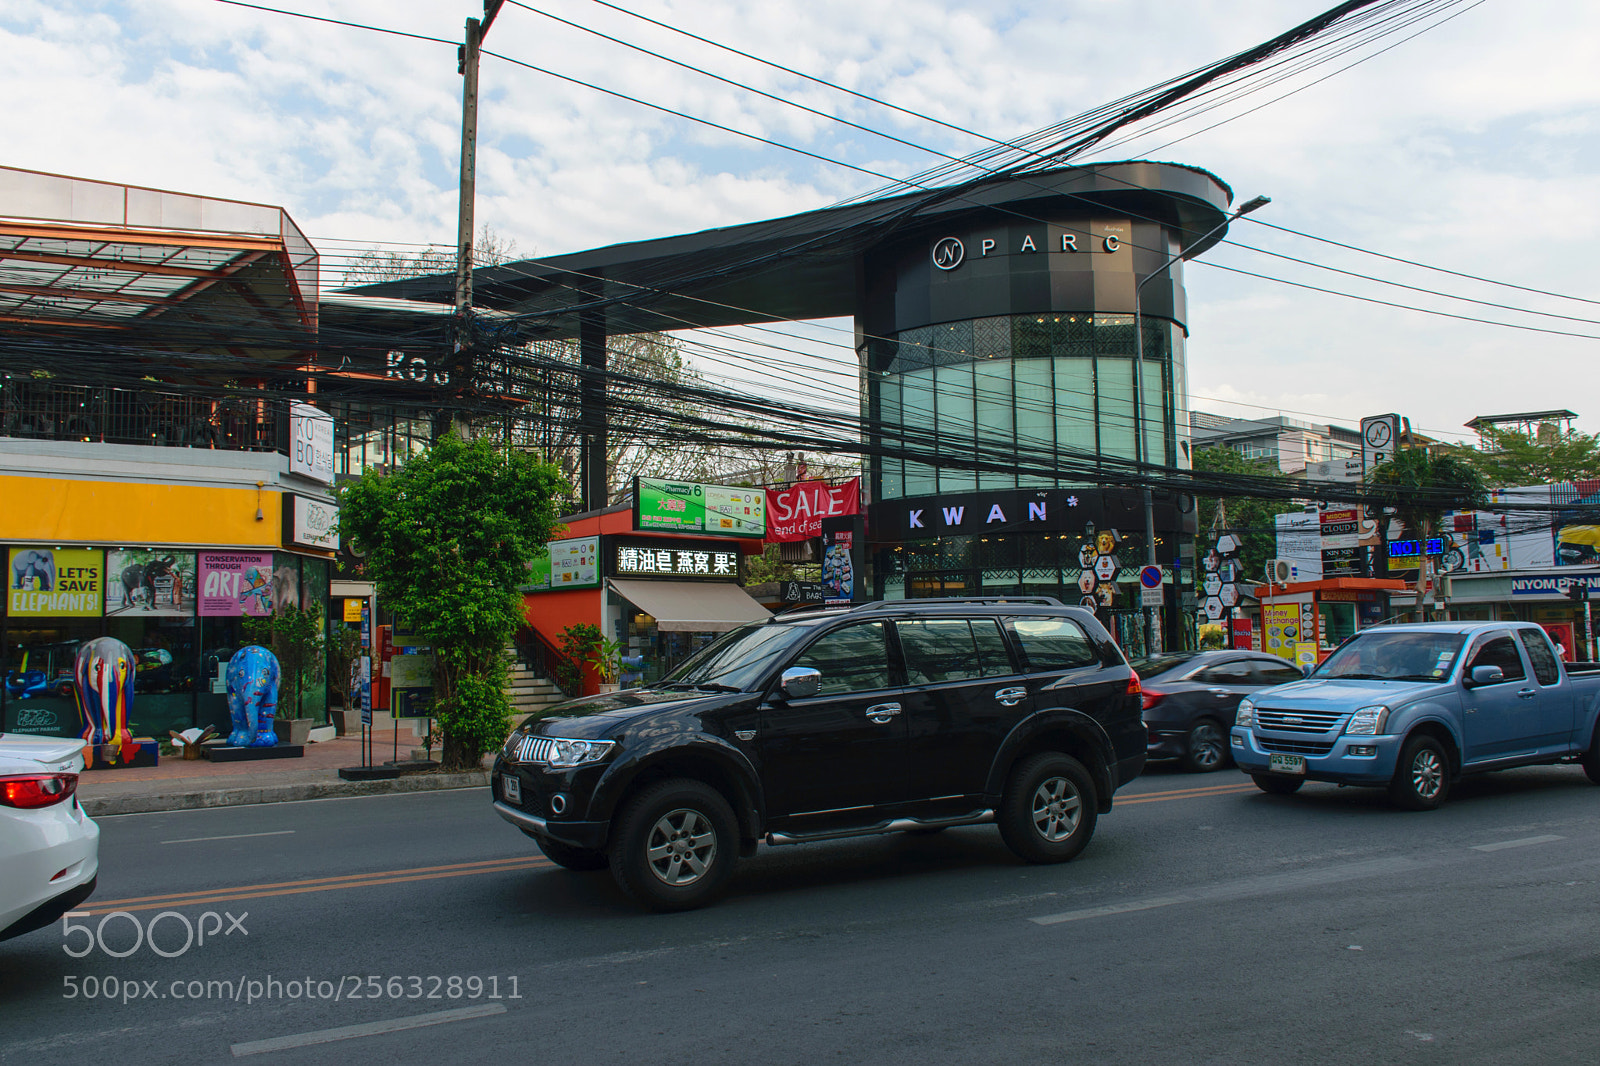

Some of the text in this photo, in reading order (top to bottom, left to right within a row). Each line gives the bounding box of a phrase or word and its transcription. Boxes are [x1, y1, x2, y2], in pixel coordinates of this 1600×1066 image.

[982, 234, 1120, 256] PARC
[296, 417, 313, 440] KO
[666, 486, 689, 494] Pharmacy
[694, 485, 702, 496] 6
[777, 488, 844, 521] SALE
[909, 501, 1047, 529] KWAN
[775, 522, 796, 535] end
[798, 520, 808, 533] of
[1391, 542, 1412, 555] NO
[620, 549, 672, 571] 精油皂
[677, 551, 709, 573] 燕窝
[59, 567, 98, 578] LET'S
[59, 580, 97, 591] SAVE
[204, 571, 242, 599] ART
[1512, 579, 1556, 590] NIYOM
[12, 592, 99, 612] ELEPHANTS!
[1265, 617, 1299, 625] Exchange
